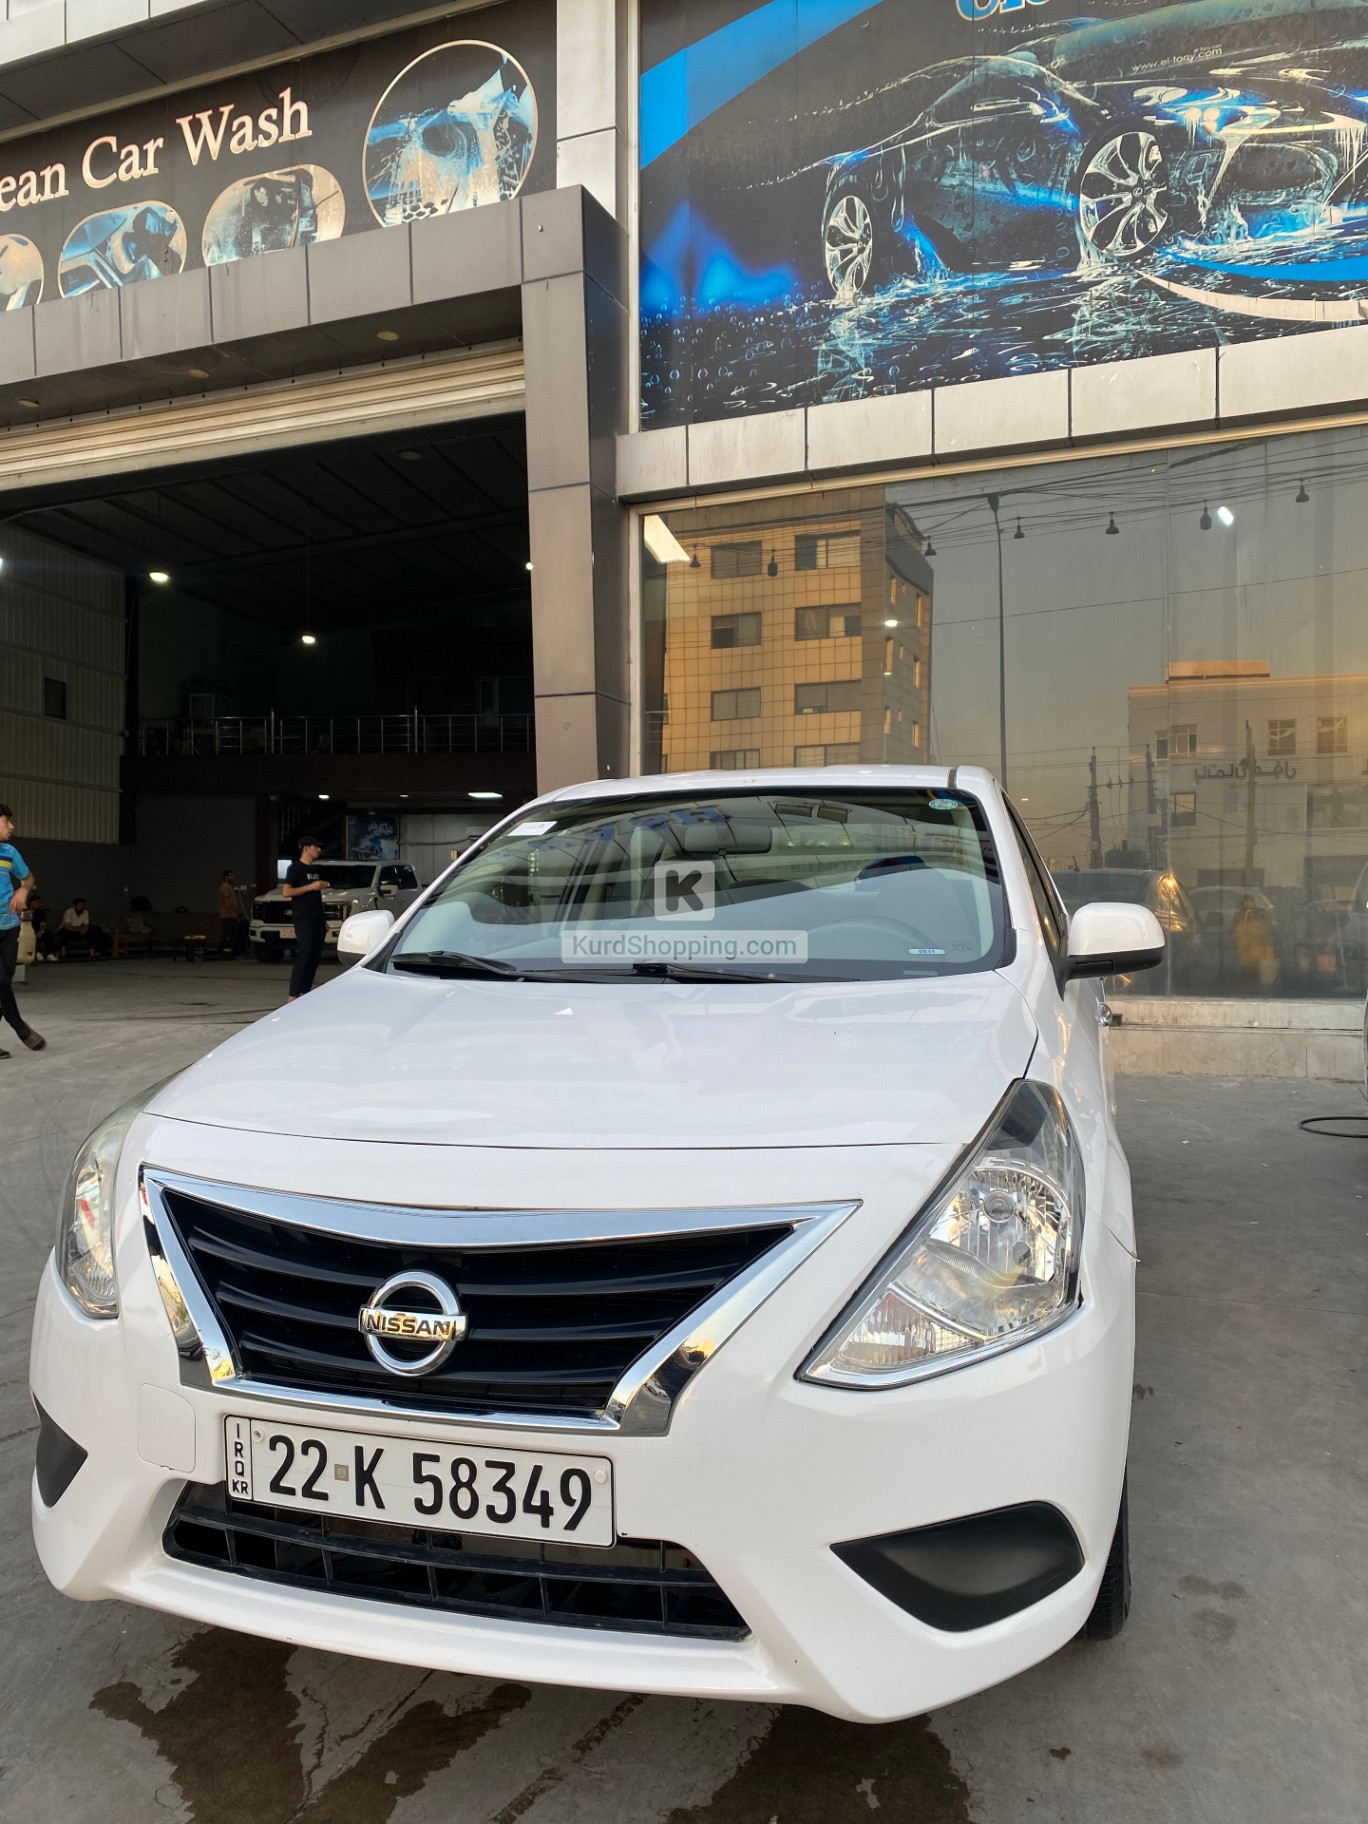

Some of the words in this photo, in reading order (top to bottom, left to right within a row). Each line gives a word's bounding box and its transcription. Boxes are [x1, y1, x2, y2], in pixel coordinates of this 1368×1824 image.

[1131, 47, 1223, 72] www.el-tony.com
[82, 135, 164, 188] Car
[175, 87, 312, 166] Wash
[365, 1313, 453, 1337] NISSAN
[231, 1478, 249, 1495] KR
[268, 1434, 329, 1501] 22
[354, 1445, 386, 1510] K
[412, 1452, 592, 1531] 58349
